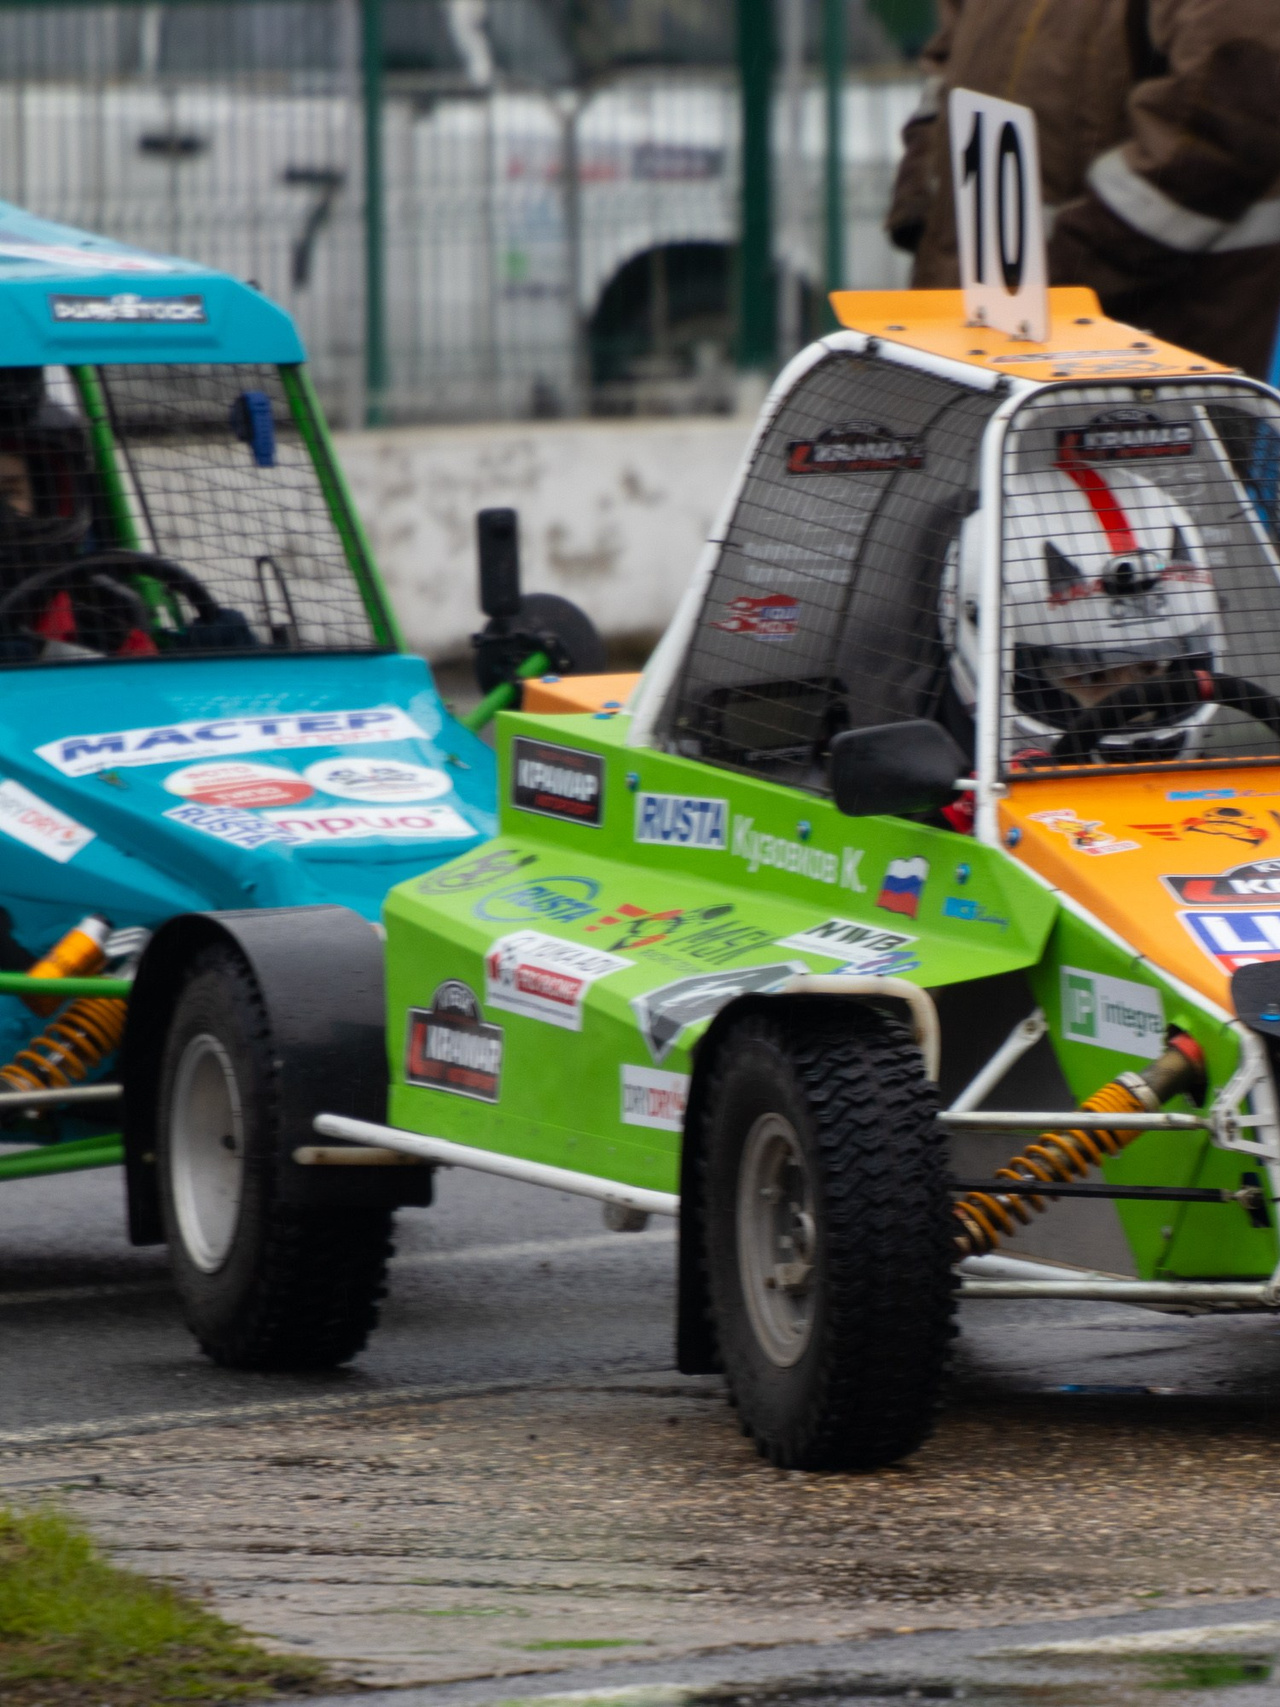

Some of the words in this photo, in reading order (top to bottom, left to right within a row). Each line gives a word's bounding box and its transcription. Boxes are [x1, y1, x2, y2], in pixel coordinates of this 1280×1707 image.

[961, 111, 1025, 297] 10
[60, 711, 395, 763] МАСТЕР
[640, 797, 723, 847] RUSTA
[1100, 994, 1163, 1038] integra
